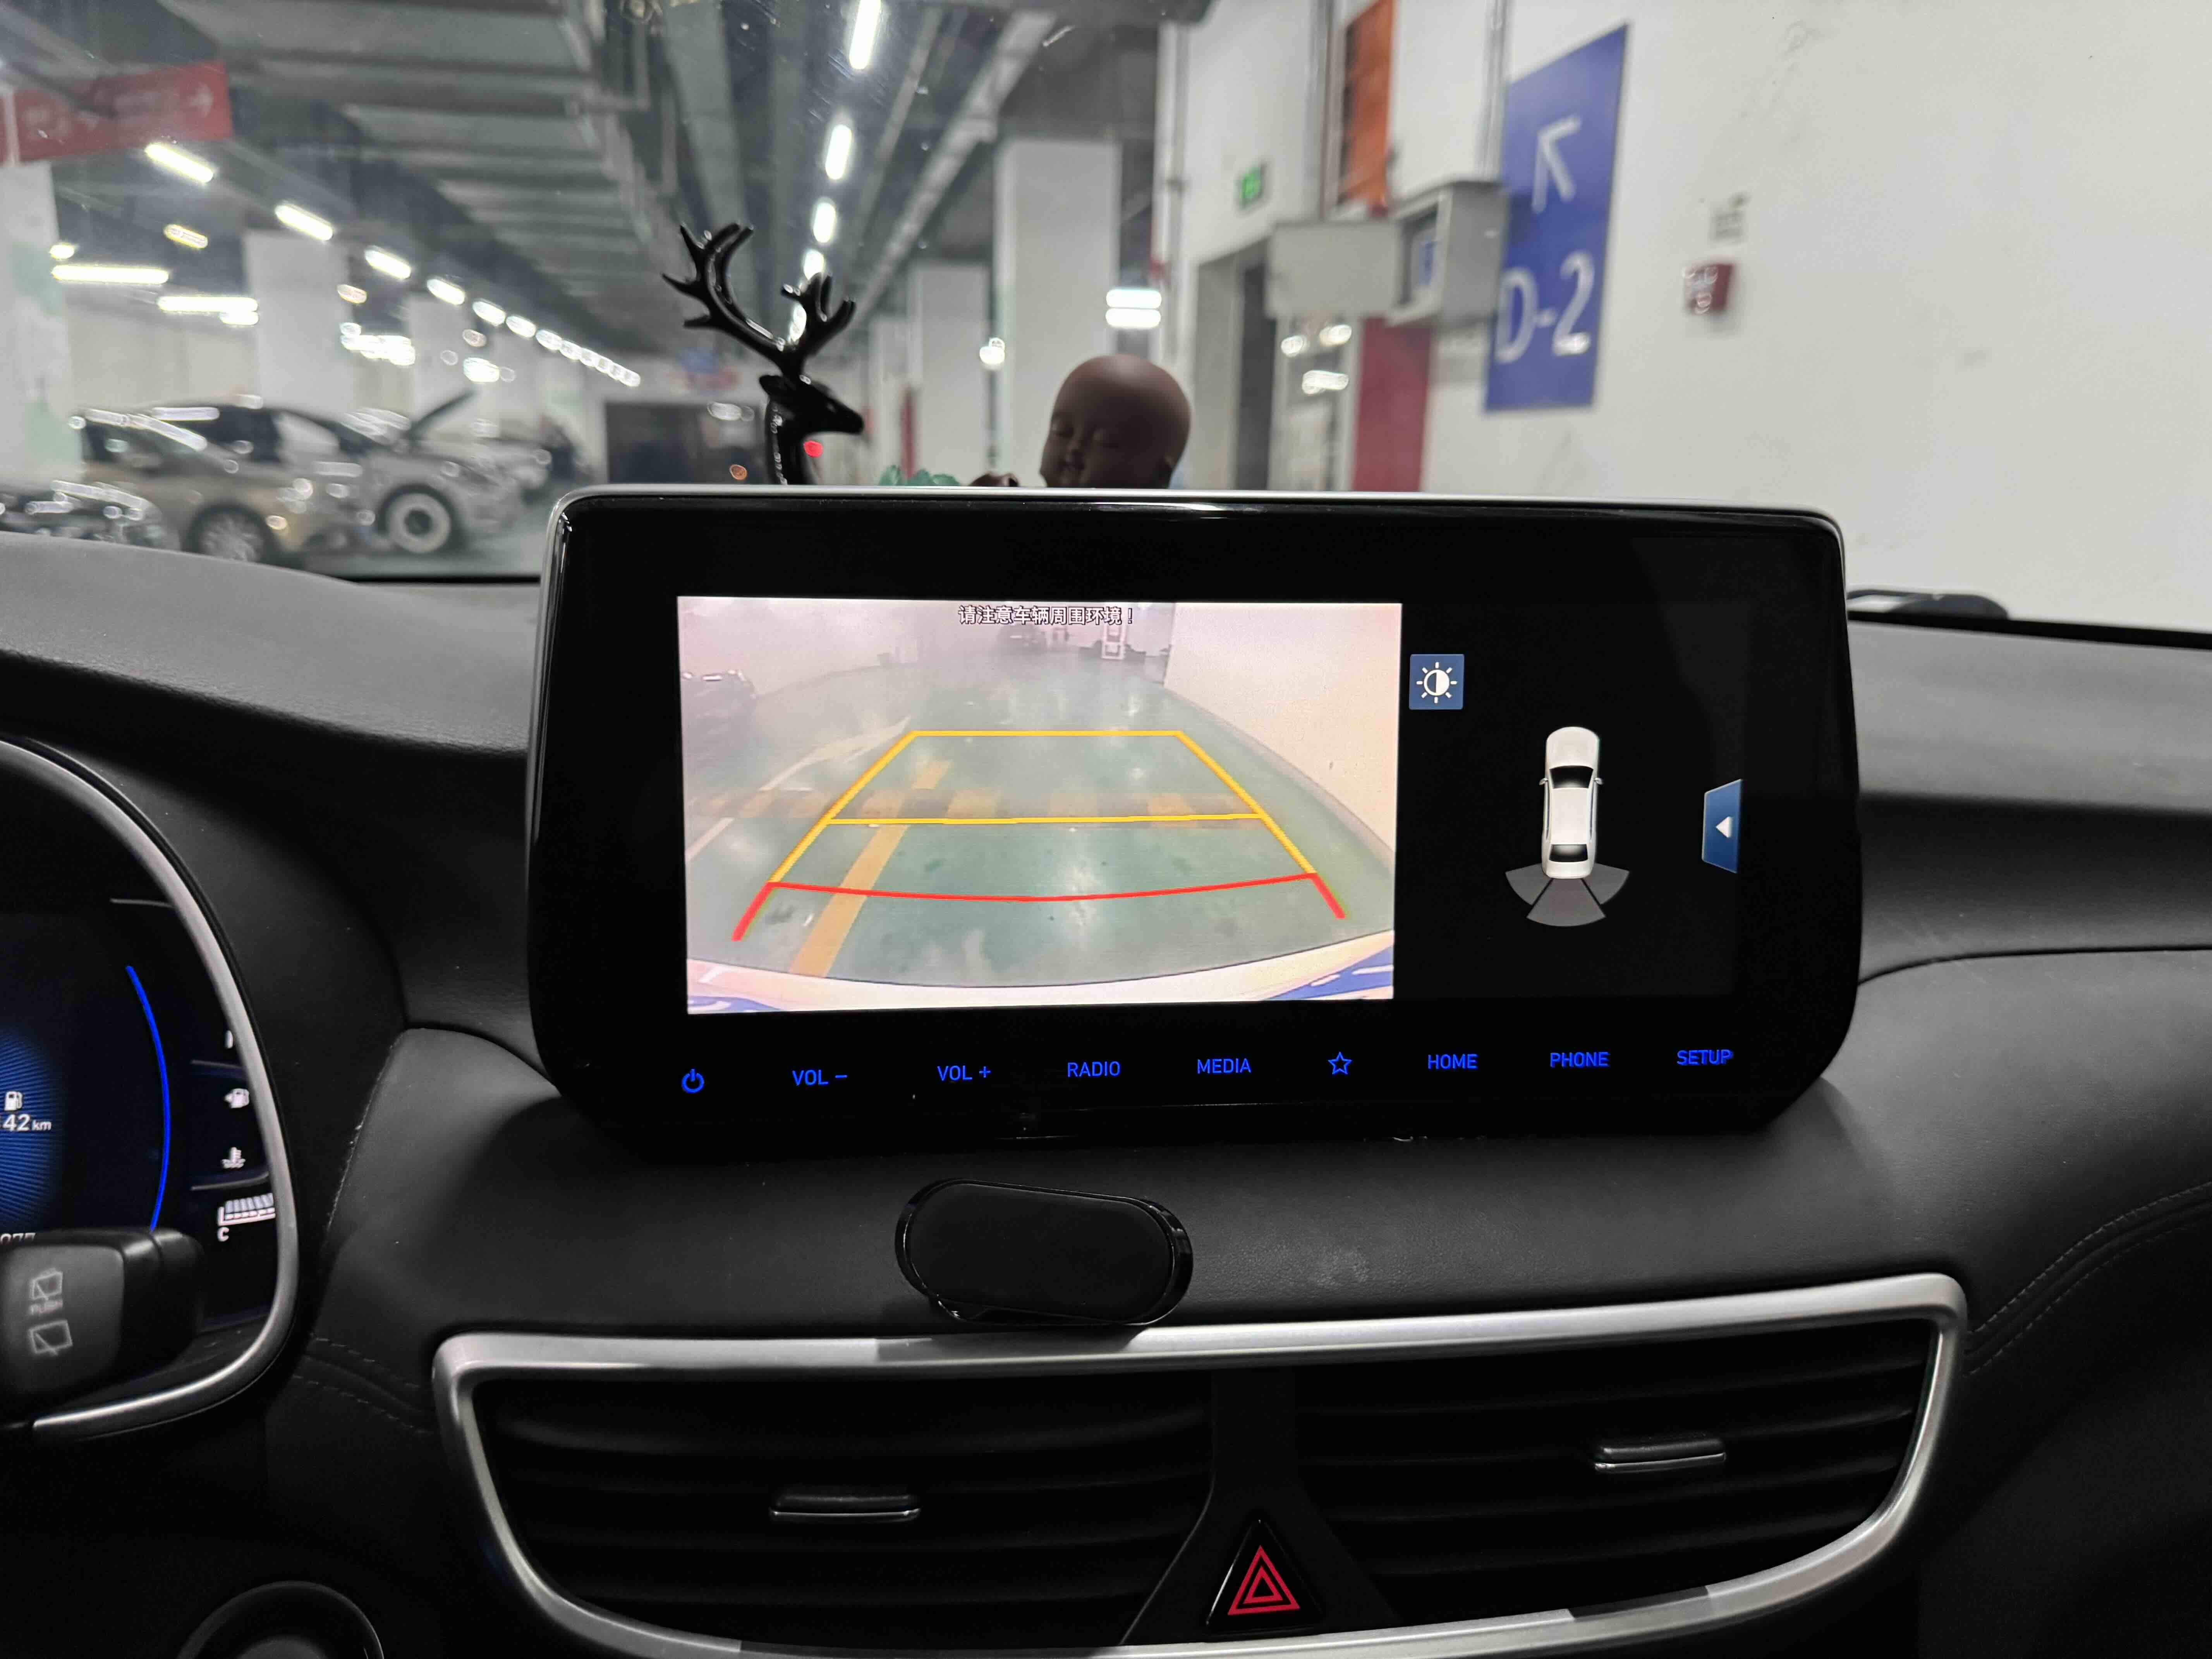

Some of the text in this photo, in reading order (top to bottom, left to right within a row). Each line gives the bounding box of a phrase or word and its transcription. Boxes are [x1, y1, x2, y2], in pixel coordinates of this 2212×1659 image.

[1494, 250, 1594, 363] D-2
[1427, 1053, 1478, 1070] HOME
[1550, 1051, 1609, 1068] PHONE
[1676, 1049, 1733, 1066] SETUP
[936, 1065, 973, 1081] VOL
[1067, 1061, 1121, 1077] RADIO
[1197, 1058, 1252, 1074] MEDIA
[792, 1069, 829, 1086] VOL
[32, 1120, 52, 1130] km
[218, 1227, 229, 1242] C
